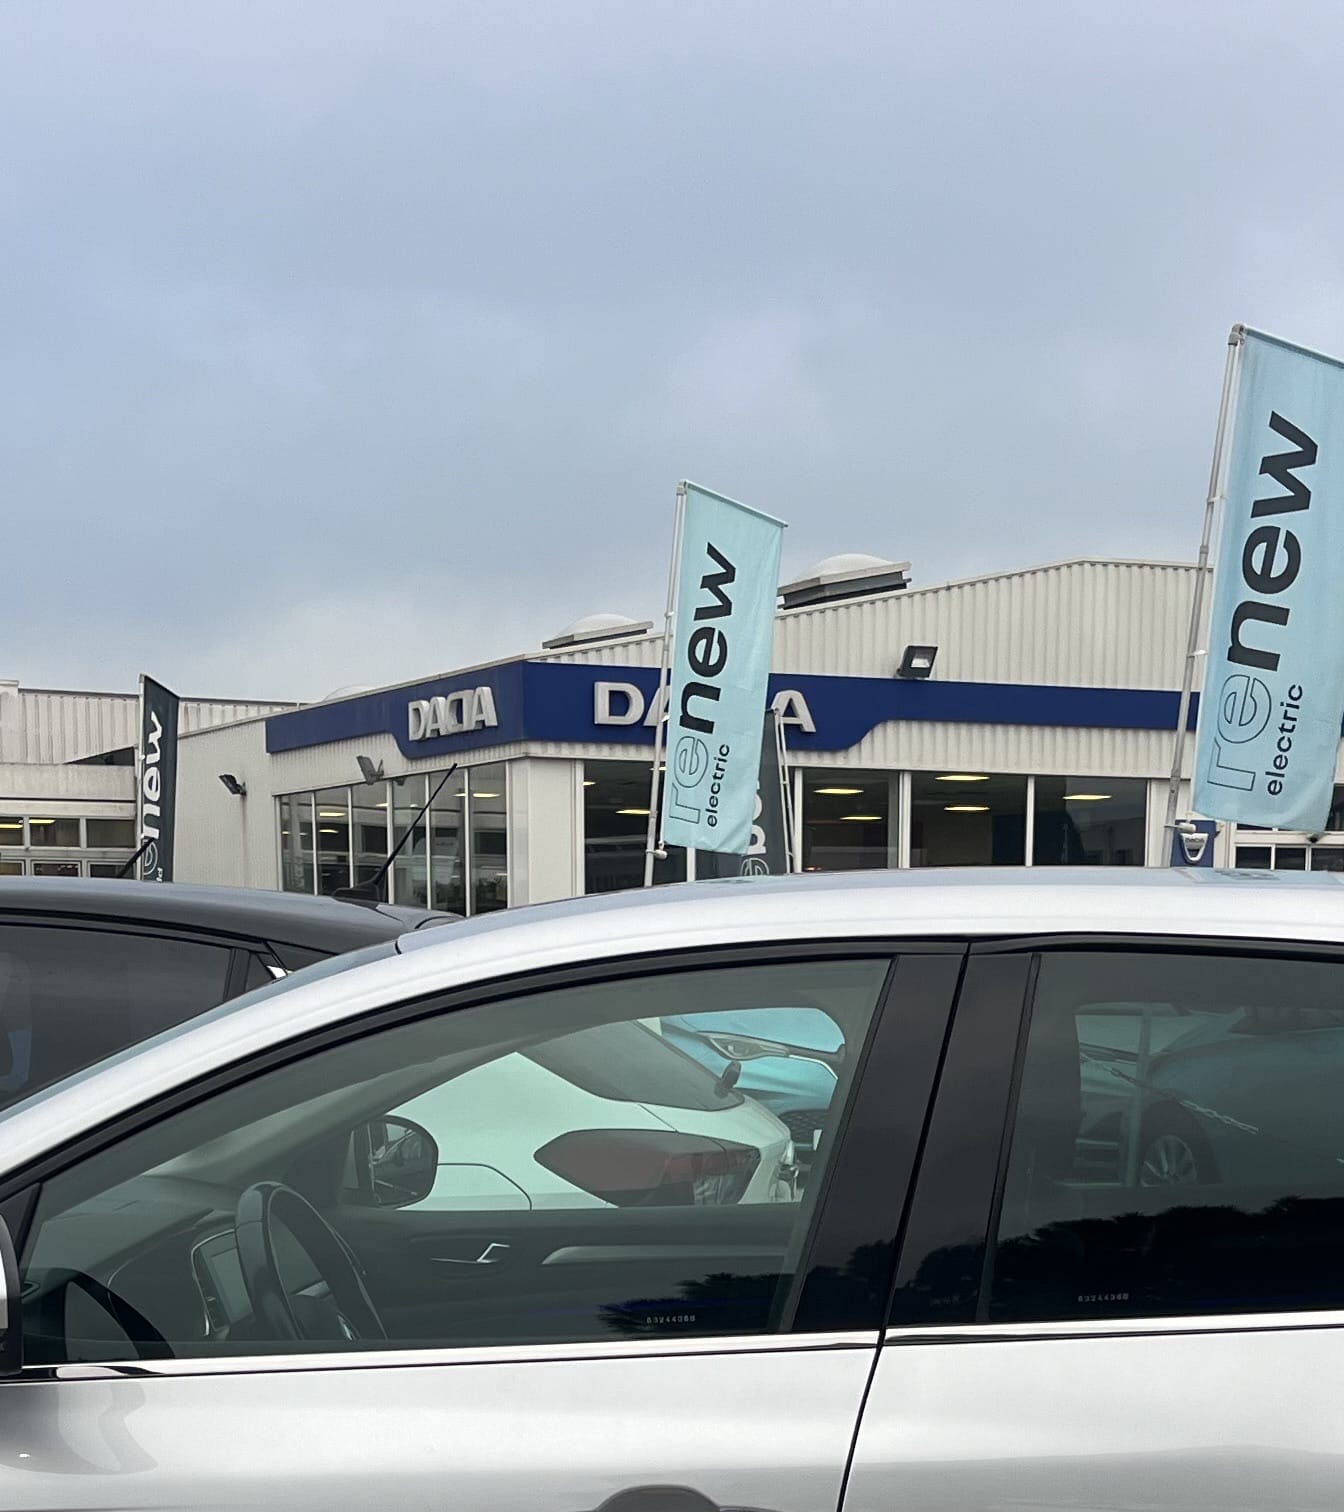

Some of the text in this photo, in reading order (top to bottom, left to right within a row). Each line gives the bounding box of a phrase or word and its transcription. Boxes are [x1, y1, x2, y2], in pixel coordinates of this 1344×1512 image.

[1207, 410, 1319, 792] renew
[408, 686, 498, 741] DACIA
[669, 541, 737, 825] renew
[705, 743, 731, 828] electric
[1264, 684, 1304, 797] electric
